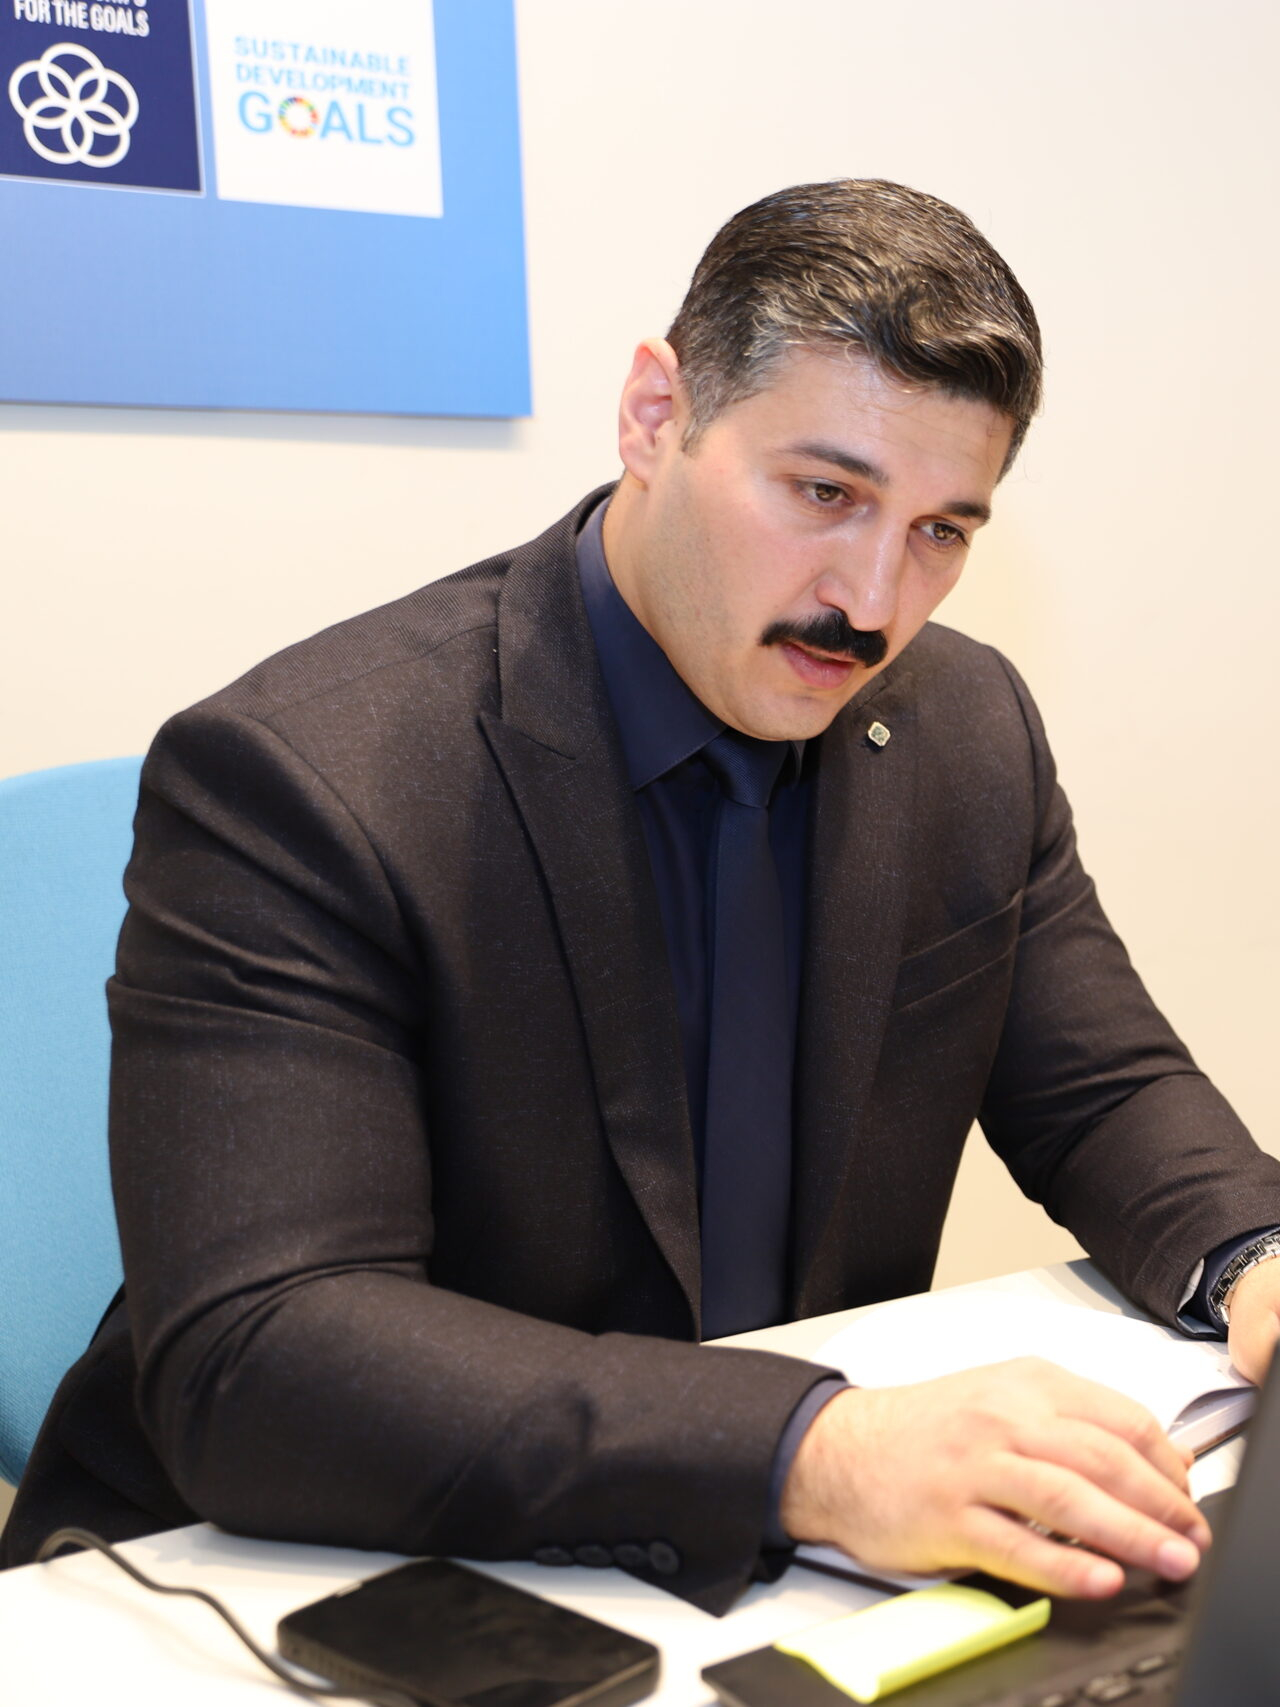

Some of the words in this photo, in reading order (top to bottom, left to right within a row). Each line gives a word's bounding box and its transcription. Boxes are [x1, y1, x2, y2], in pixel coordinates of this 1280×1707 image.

[14, 0, 51, 24] FOR
[52, 0, 89, 29] THE
[90, 3, 150, 37] GOALS
[234, 36, 410, 76] SUSTAINABLE
[236, 63, 410, 100] DEVELOPMENT
[238, 91, 416, 147] GOALS
